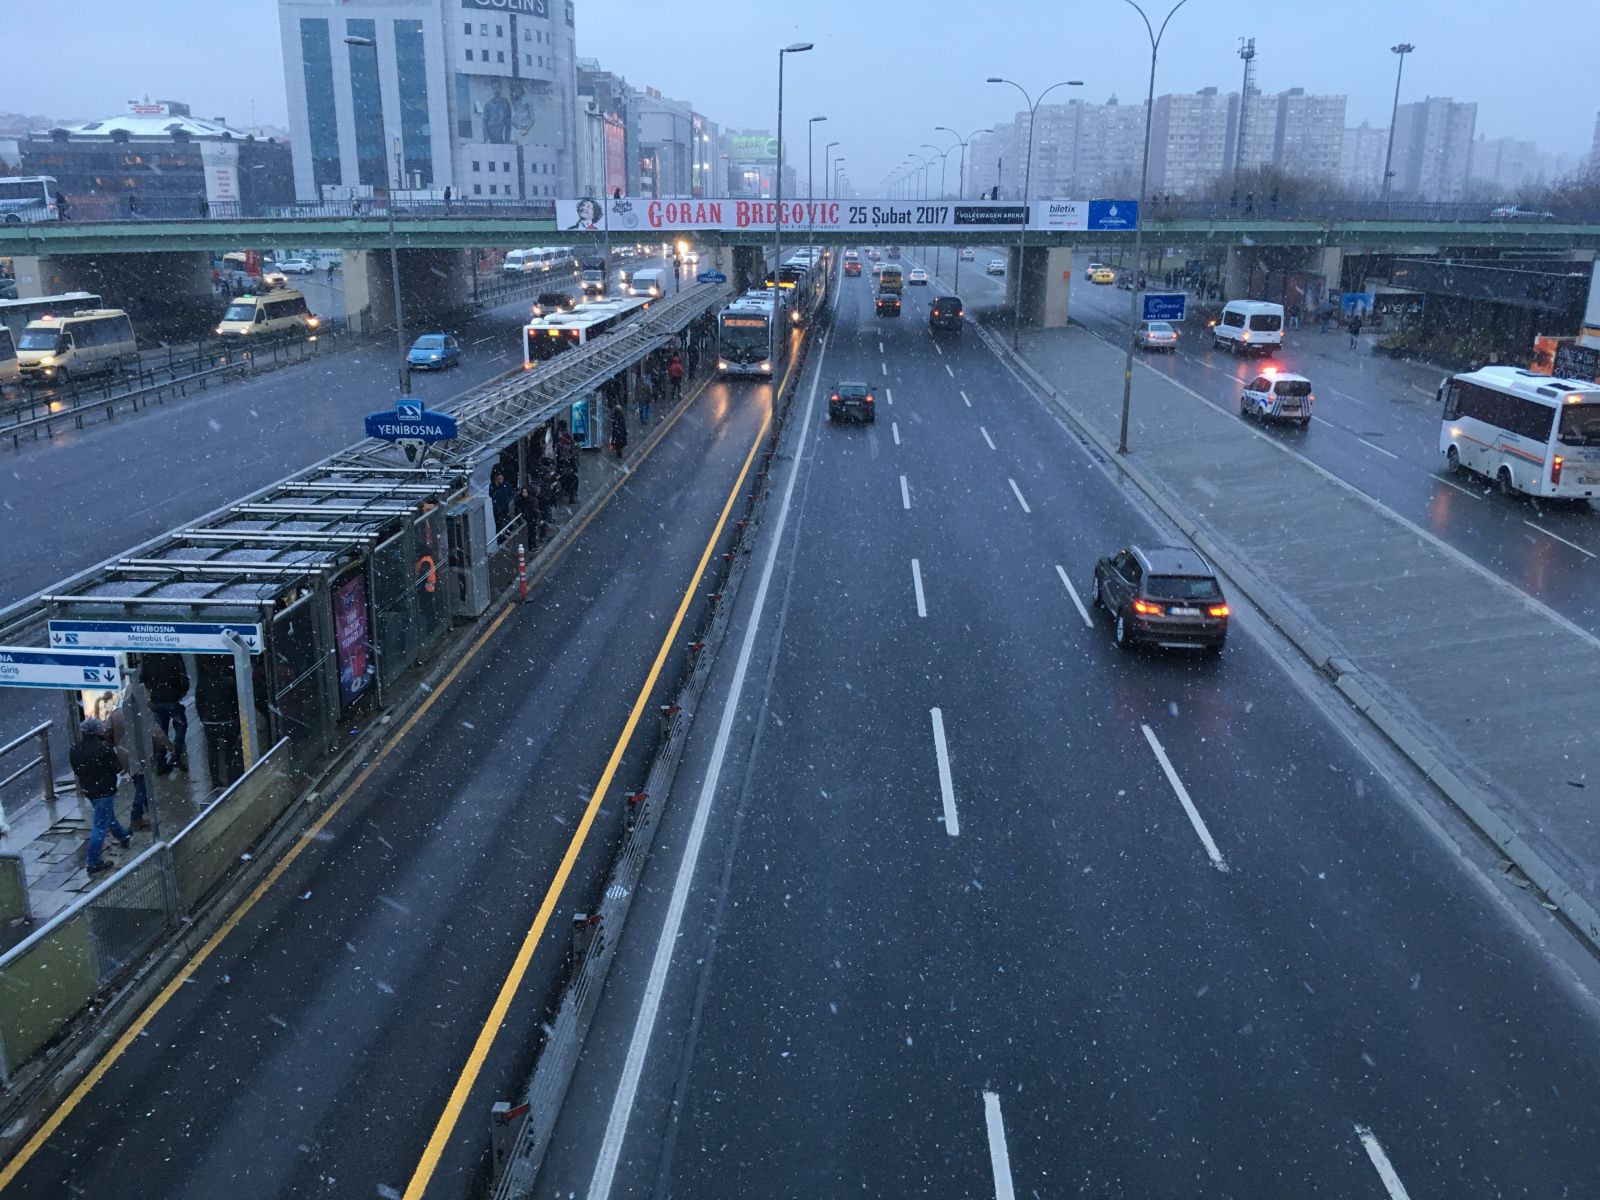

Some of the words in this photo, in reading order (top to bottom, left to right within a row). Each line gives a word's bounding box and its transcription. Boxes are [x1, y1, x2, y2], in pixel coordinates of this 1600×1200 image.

[1049, 204, 1076, 213] biletix
[648, 201, 722, 228] GORAN
[736, 201, 840, 228] BREGOVIC
[849, 206, 867, 224] 25
[872, 206, 912, 228] Şubat
[916, 206, 949, 224] 2017
[377, 422, 443, 436] YENİBOSNA
[131, 624, 176, 633] YENİBOSNA
[164, 635, 180, 643] Giriş
[0, 665, 20, 676] Giriş
